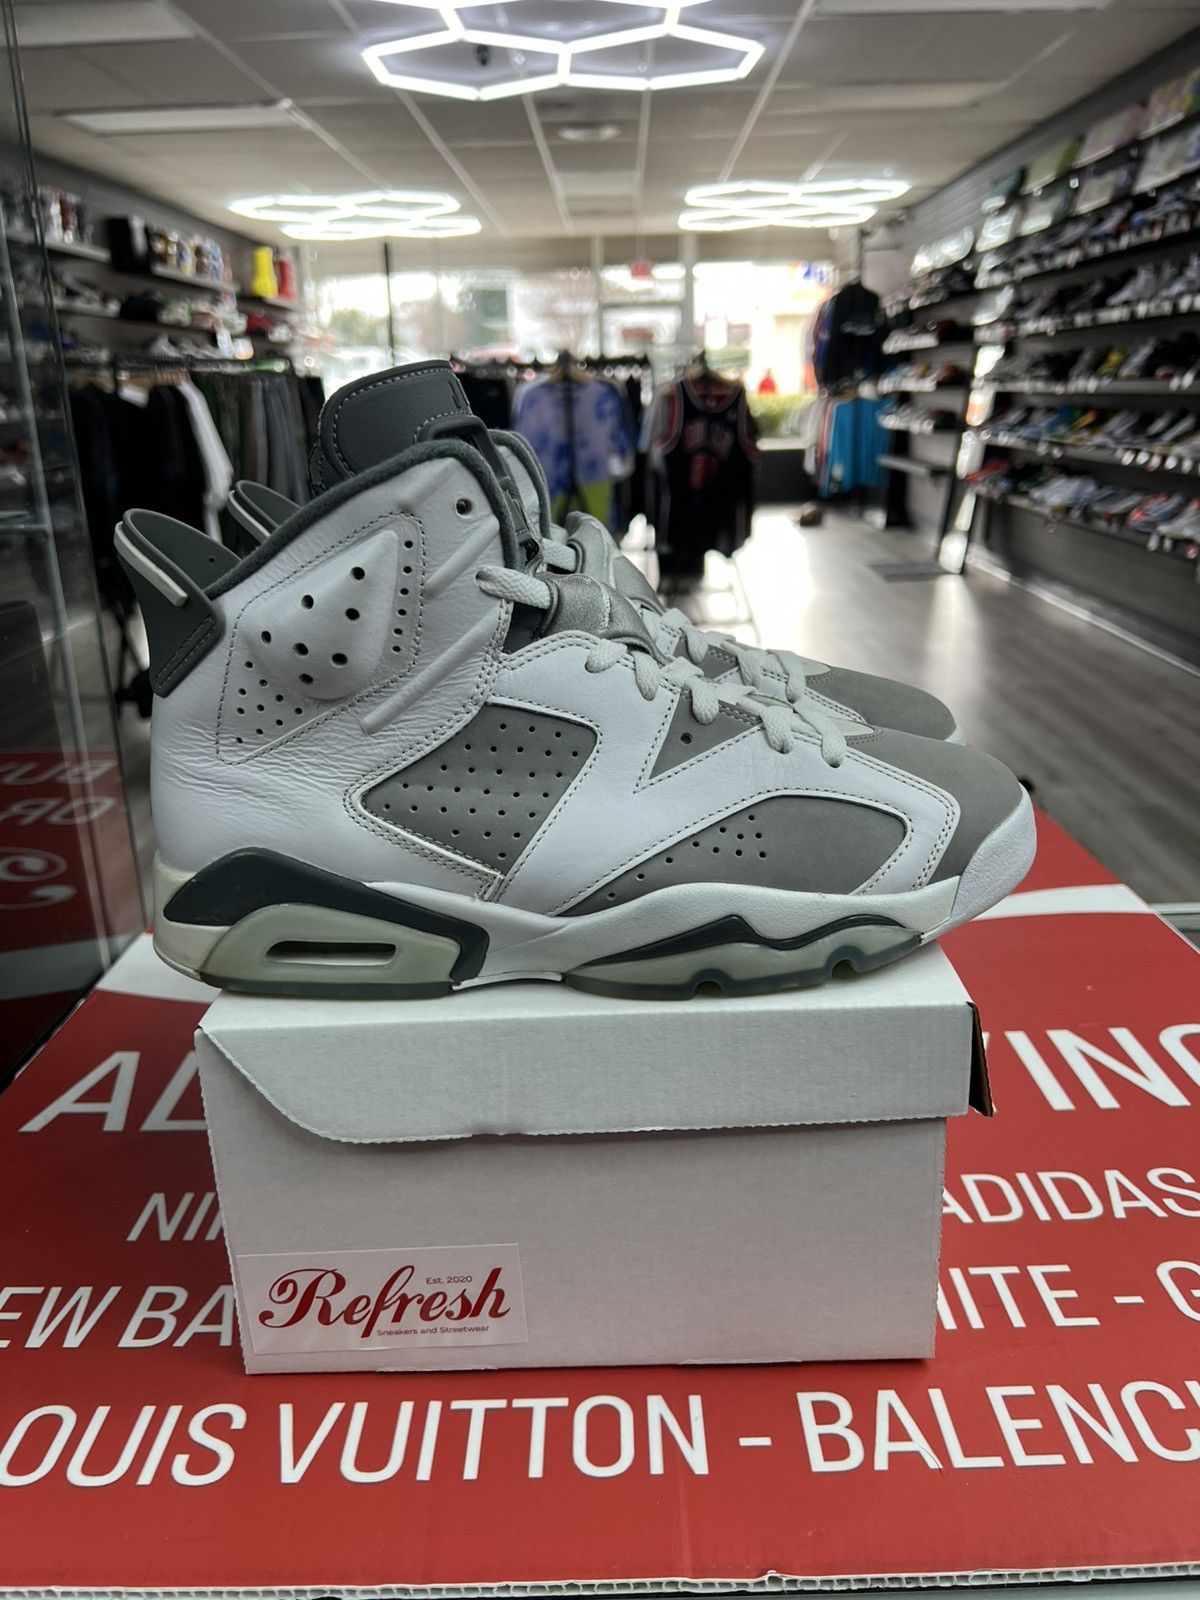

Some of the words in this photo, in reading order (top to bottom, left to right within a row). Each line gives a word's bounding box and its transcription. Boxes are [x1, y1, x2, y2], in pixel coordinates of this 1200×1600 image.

[447, 1275, 473, 1283] 2020
[258, 1264, 511, 1338] Refresh
[377, 1328, 418, 1336] Sneakers
[420, 1326, 438, 1334] and
[440, 1325, 490, 1333] Streetwear
[280, 1395, 708, 1483] VUITTON
